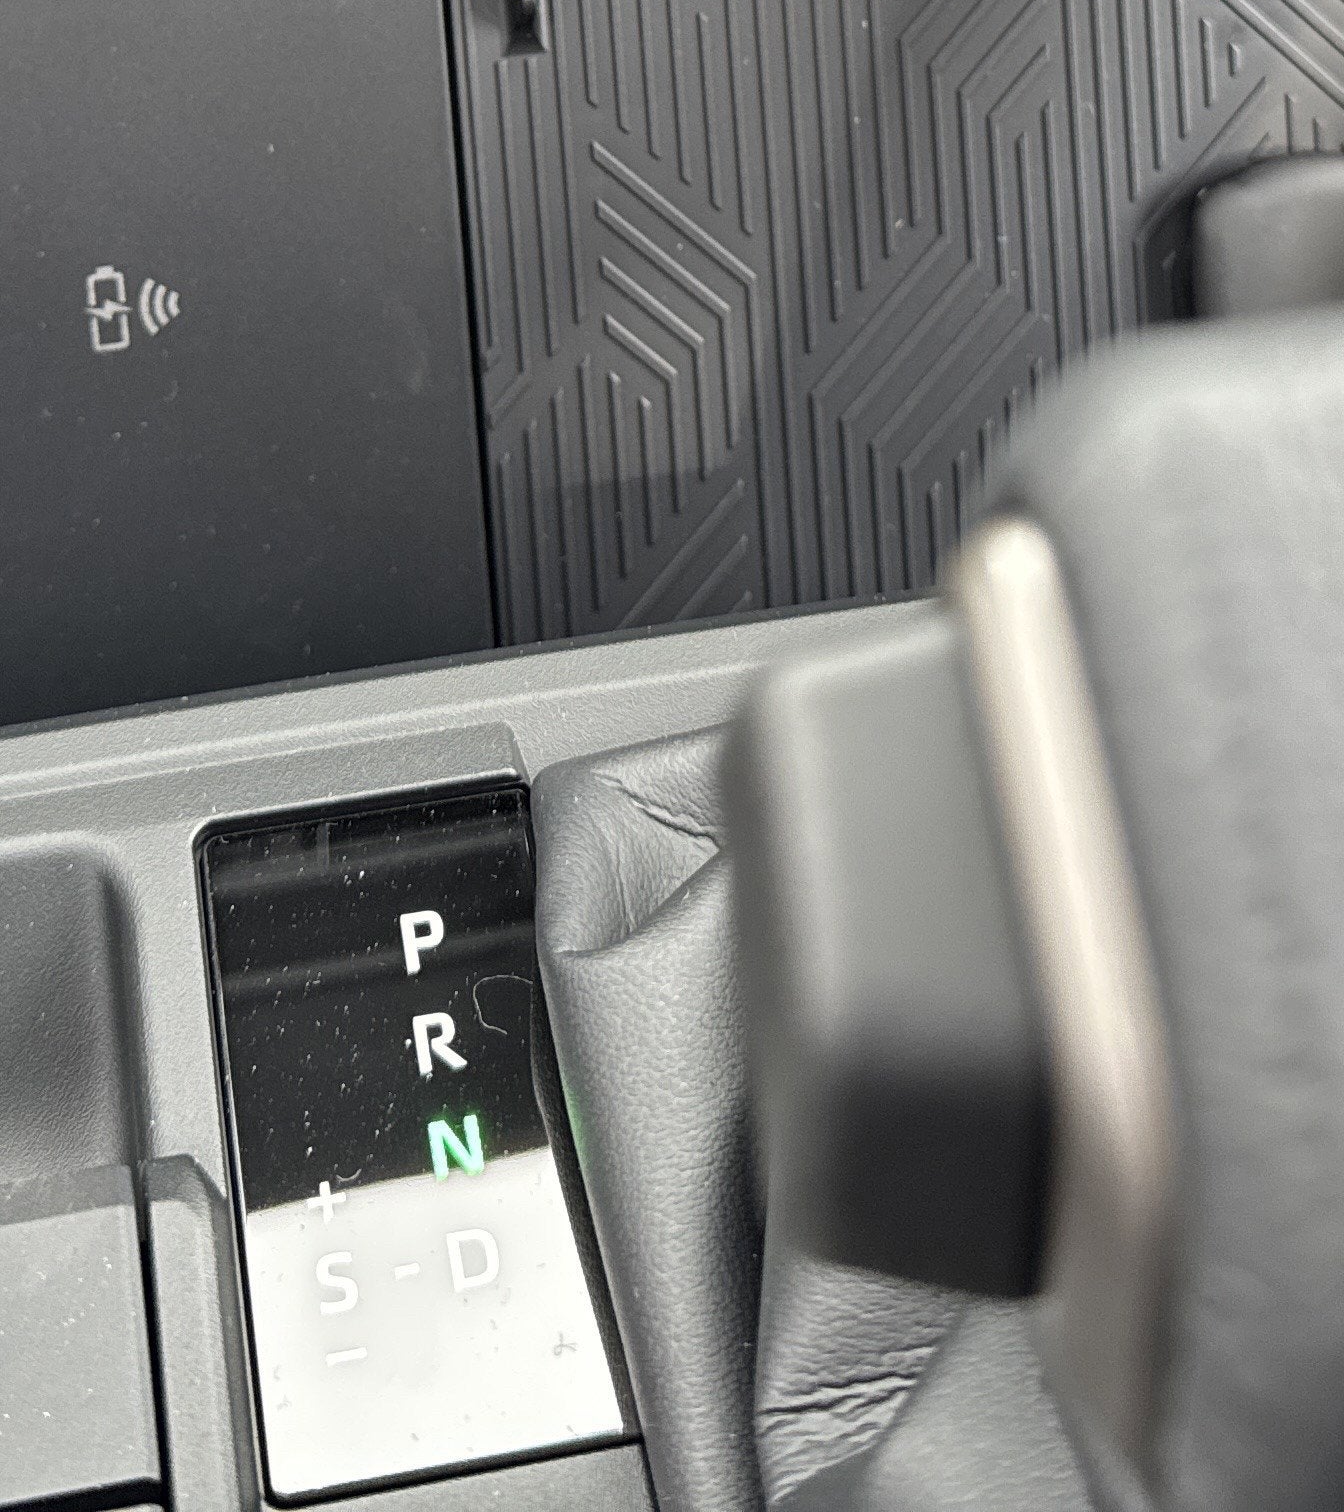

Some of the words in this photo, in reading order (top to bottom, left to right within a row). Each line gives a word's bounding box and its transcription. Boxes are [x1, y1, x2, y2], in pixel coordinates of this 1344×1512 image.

[399, 909, 444, 976] P
[412, 1011, 468, 1076] R
[427, 1113, 485, 1181] N
[315, 1251, 359, 1315] S
[446, 1228, 500, 1292] D
